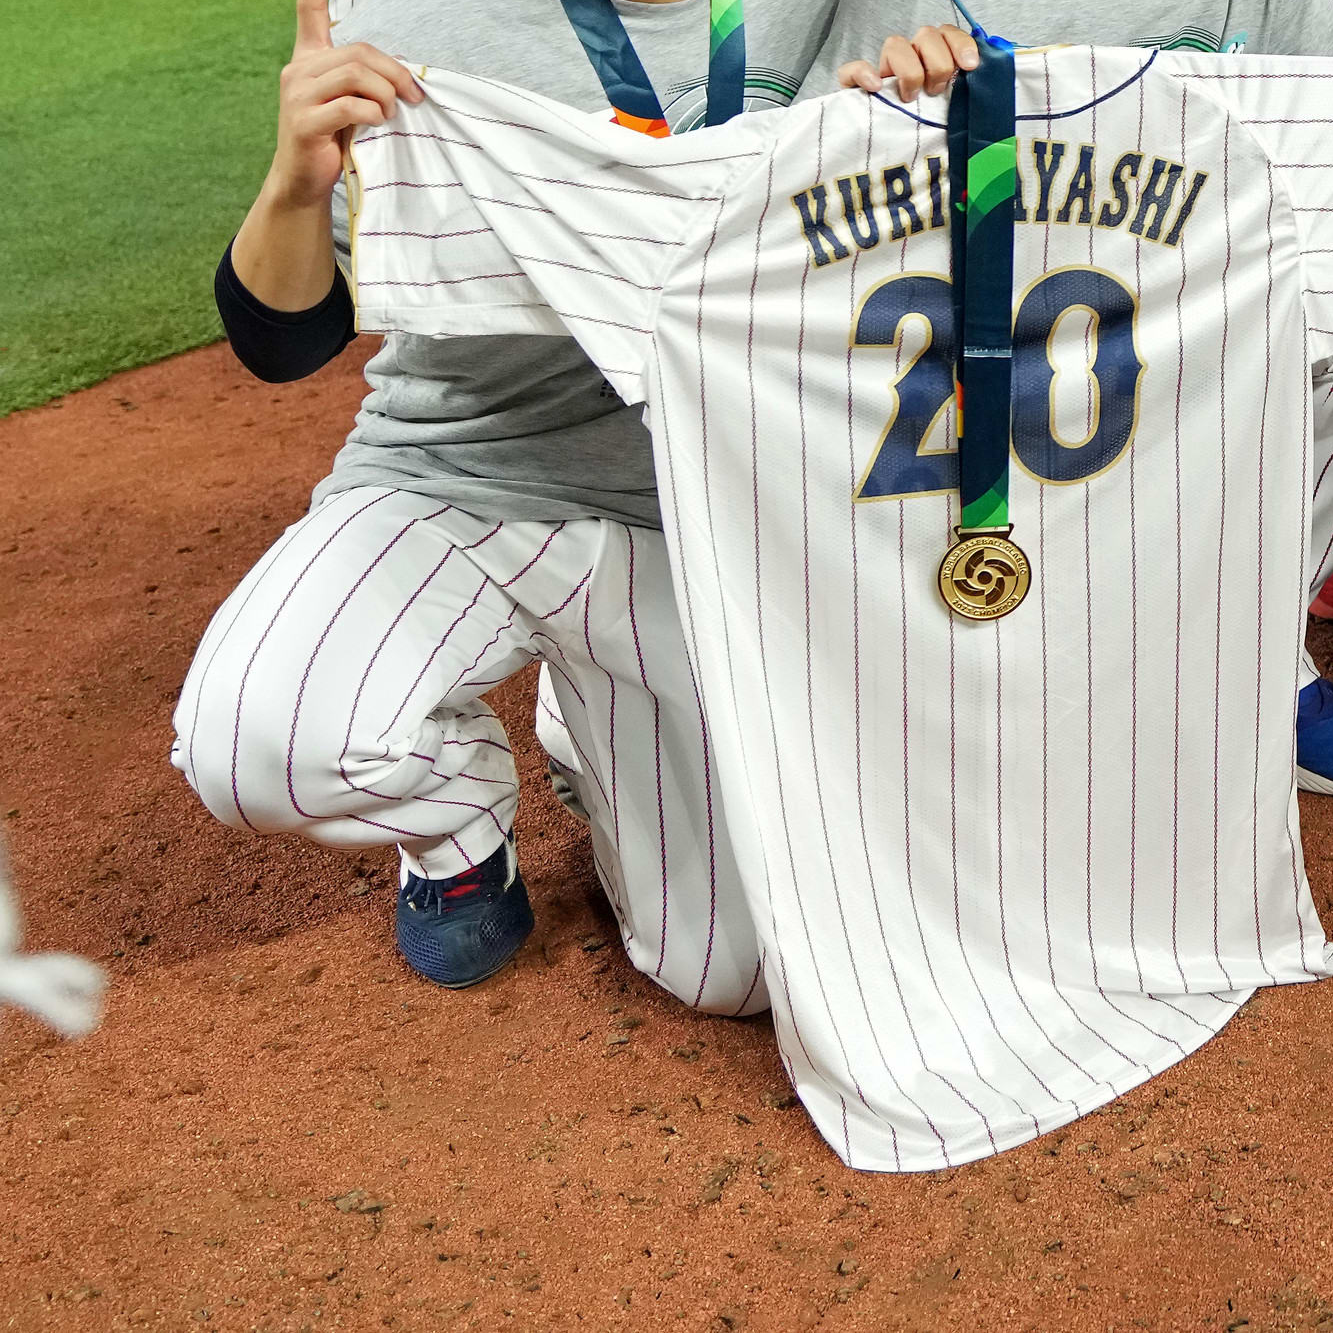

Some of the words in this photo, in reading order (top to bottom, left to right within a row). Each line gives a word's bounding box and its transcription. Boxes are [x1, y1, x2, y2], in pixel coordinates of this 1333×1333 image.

[791, 137, 1209, 269] KURIYASHI
[849, 265, 1148, 503] 20
[943, 551, 960, 580] WORLD
[960, 539, 1004, 553] BASEBALL
[1004, 544, 1026, 576] CLASSIC
[972, 595, 1019, 617] CHAMPION
